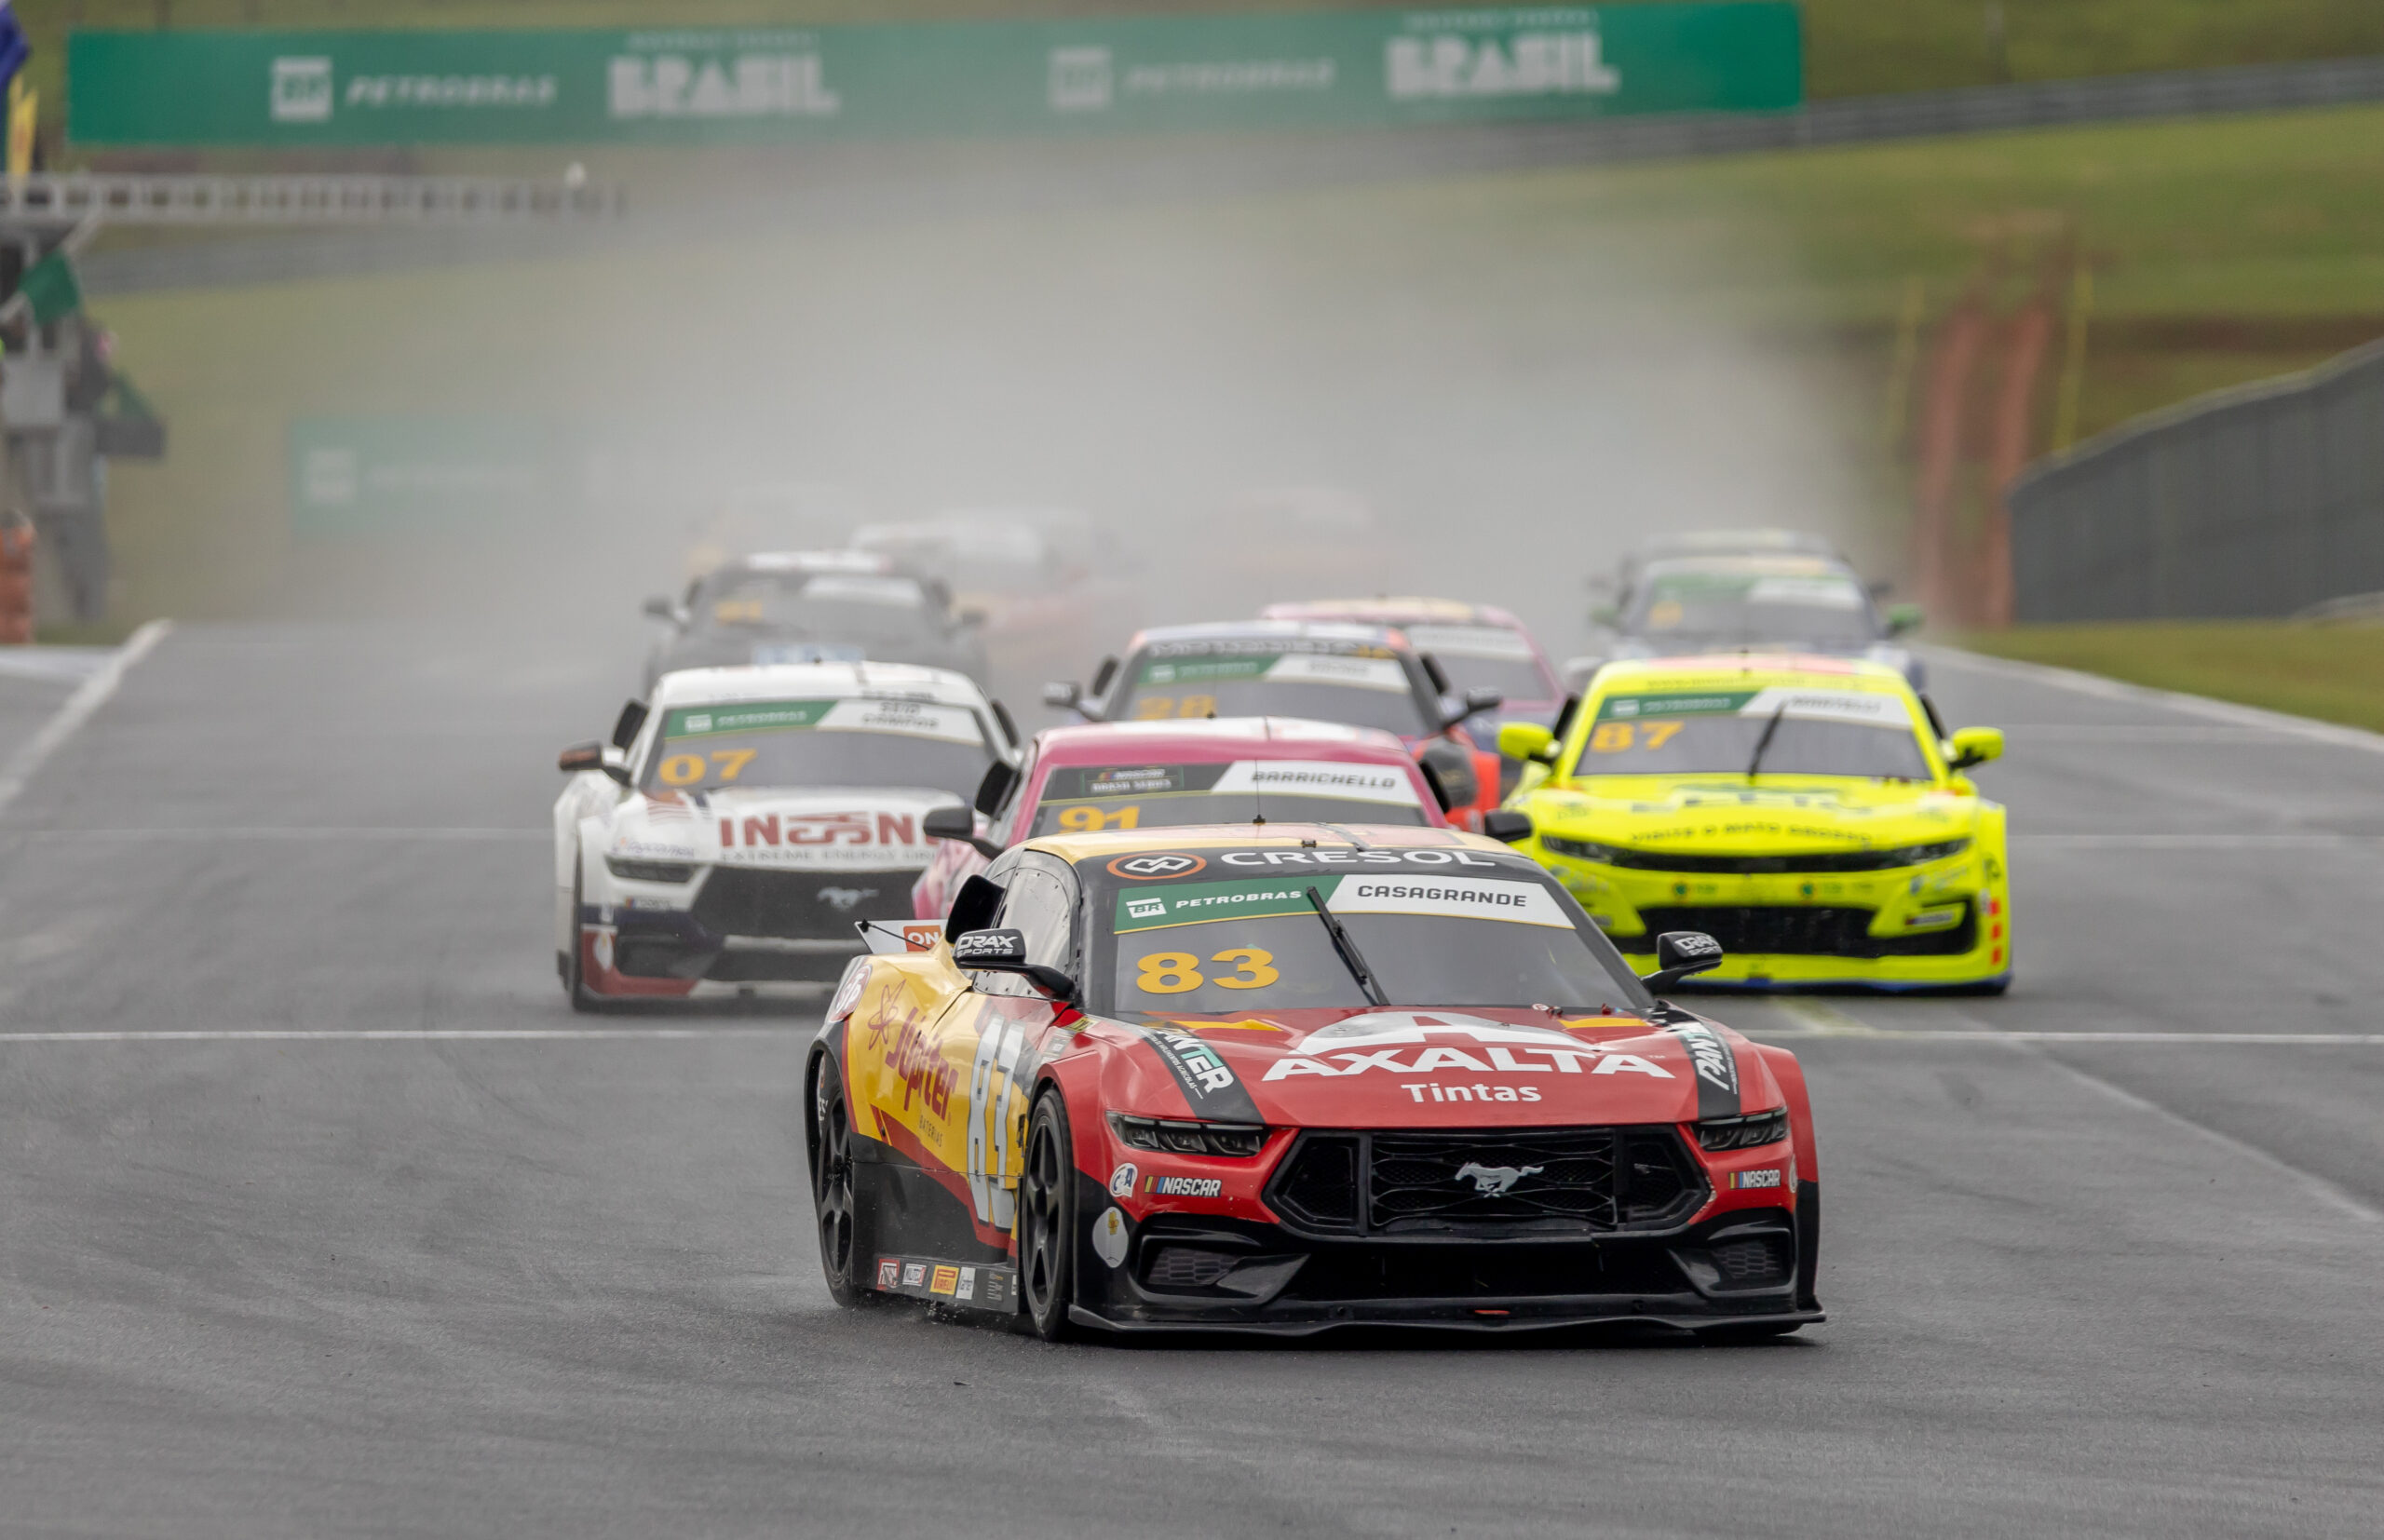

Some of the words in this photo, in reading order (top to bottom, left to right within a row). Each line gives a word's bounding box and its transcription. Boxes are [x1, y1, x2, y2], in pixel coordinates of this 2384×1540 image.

[1386, 34, 1619, 100] BRASIL
[345, 74, 554, 107] PETROBRAS
[608, 54, 838, 117] BRASIL
[1589, 722, 1685, 752] 87
[658, 749, 757, 786] 07
[1251, 770, 1396, 790] BARRICHELLO
[1059, 805, 1140, 833] 91
[1221, 850, 1496, 866] CRESOL
[1175, 891, 1302, 909] PETROBRAS
[1358, 885, 1527, 908] CASAGRANDE
[956, 948, 1014, 957] SPORTS
[958, 935, 1018, 950] DRAX
[1136, 948, 1280, 993] 83
[1153, 1028, 1235, 1094] ANTER
[1261, 1047, 1677, 1082] AXALTA
[1402, 1082, 1542, 1102] Tintas
[1162, 1177, 1222, 1197] NASCAR
[1742, 1169, 1781, 1189] NASCAR
